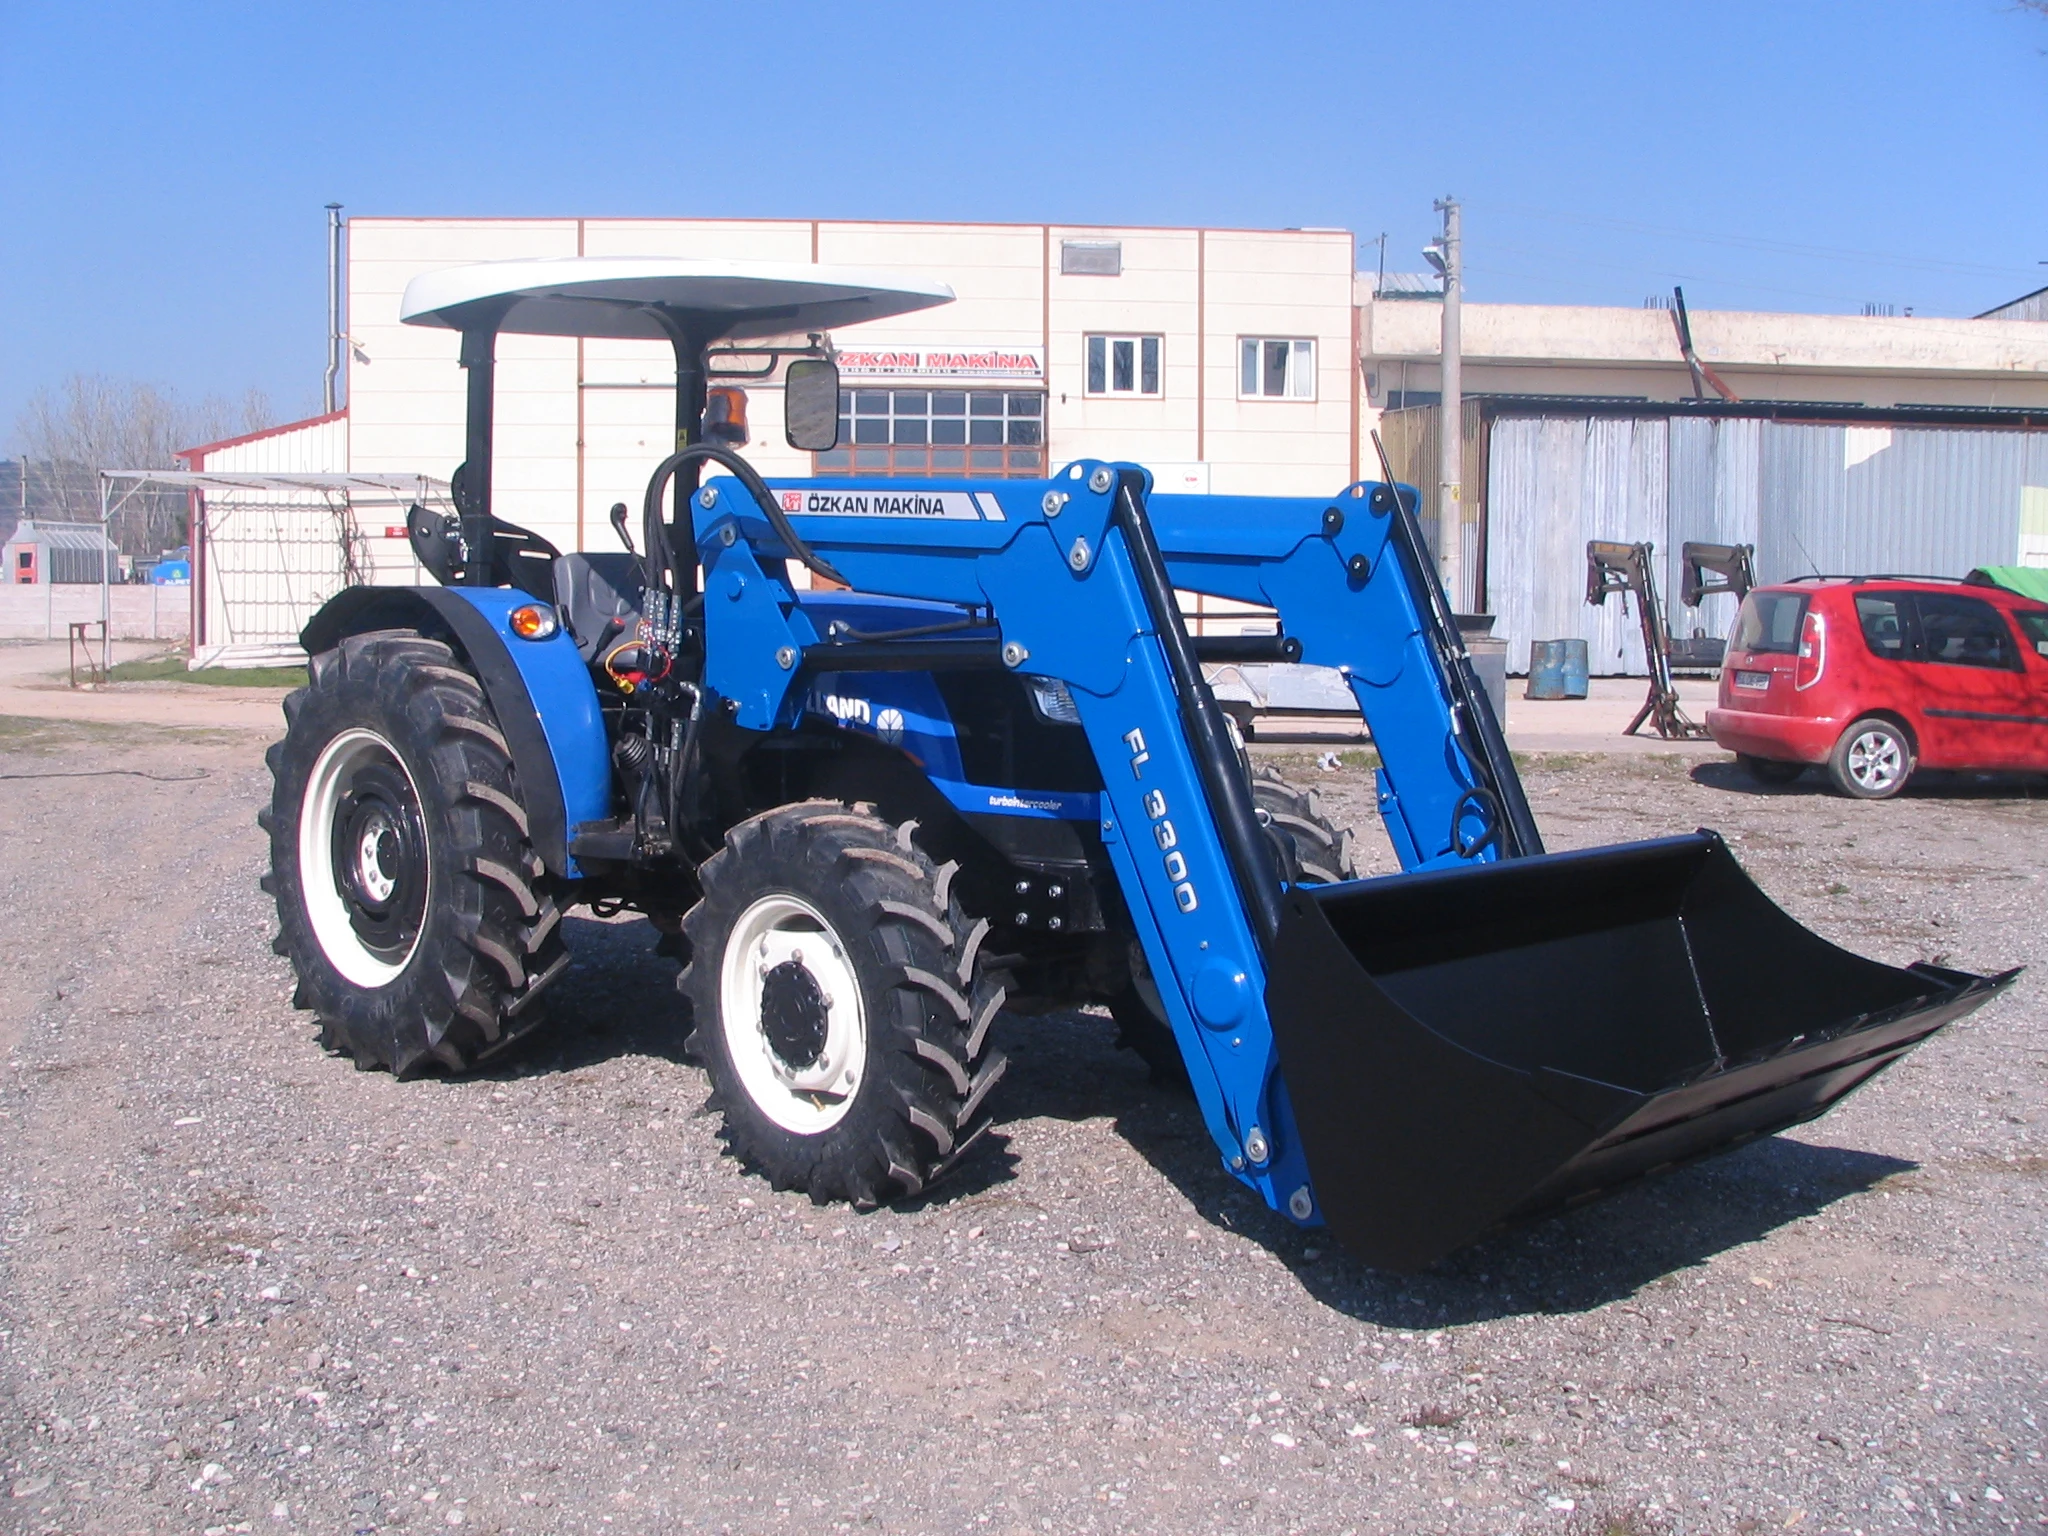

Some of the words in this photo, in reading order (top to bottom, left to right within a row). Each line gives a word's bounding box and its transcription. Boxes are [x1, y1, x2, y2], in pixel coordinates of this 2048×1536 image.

[836, 351, 919, 367] ZKAN
[926, 351, 1038, 368] MAKİNA
[808, 493, 869, 514] ÖZKAN
[873, 494, 945, 515] MAKİNA
[1122, 727, 1150, 781] FL
[1142, 788, 1199, 914] 3300
